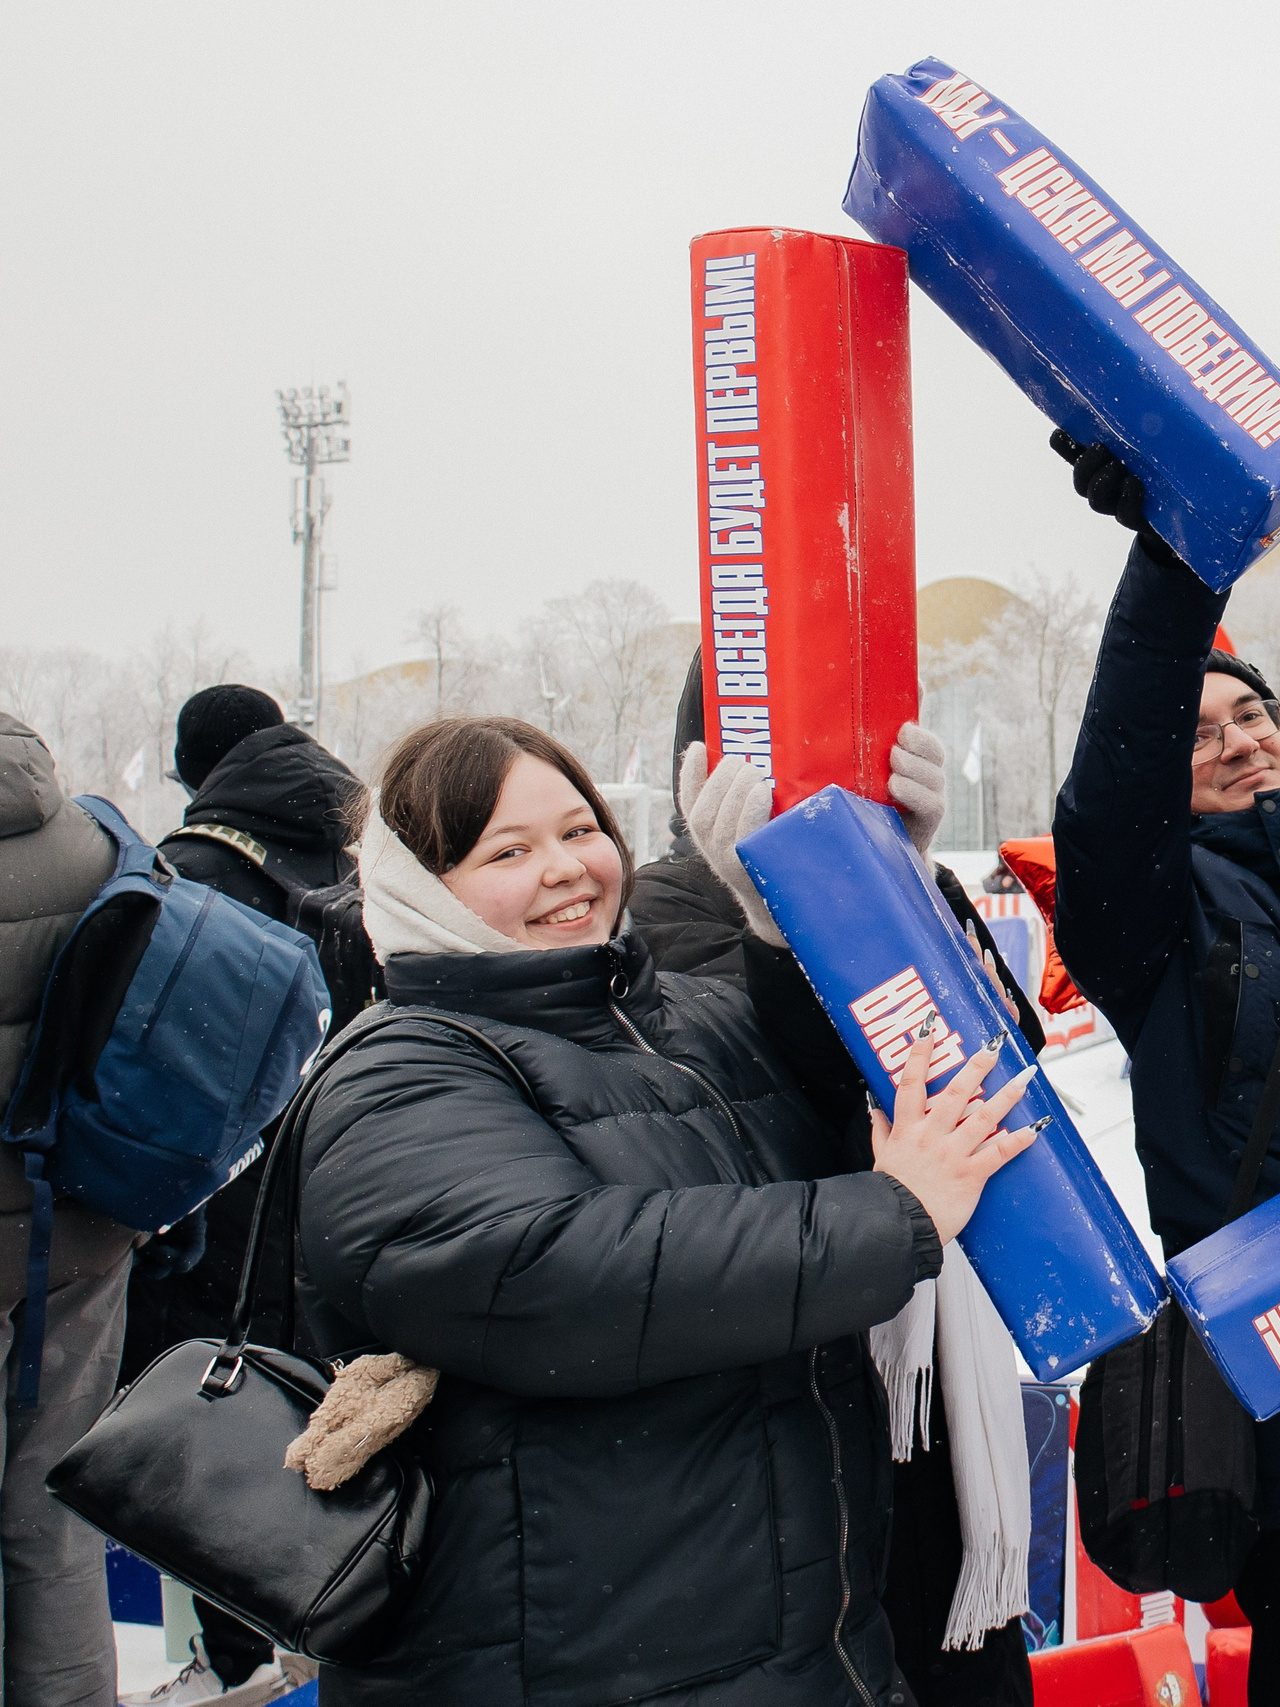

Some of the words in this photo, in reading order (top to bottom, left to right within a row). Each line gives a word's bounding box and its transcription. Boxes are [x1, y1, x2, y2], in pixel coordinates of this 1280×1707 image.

[915, 71, 1007, 140] МЫ
[996, 146, 1119, 253] ЦСКА!
[1079, 228, 1171, 309] МЫ
[704, 253, 760, 434] ПЕРВЫМ!
[706, 441, 766, 555] БУДЕТ
[710, 563, 769, 697] ВСЕГДА
